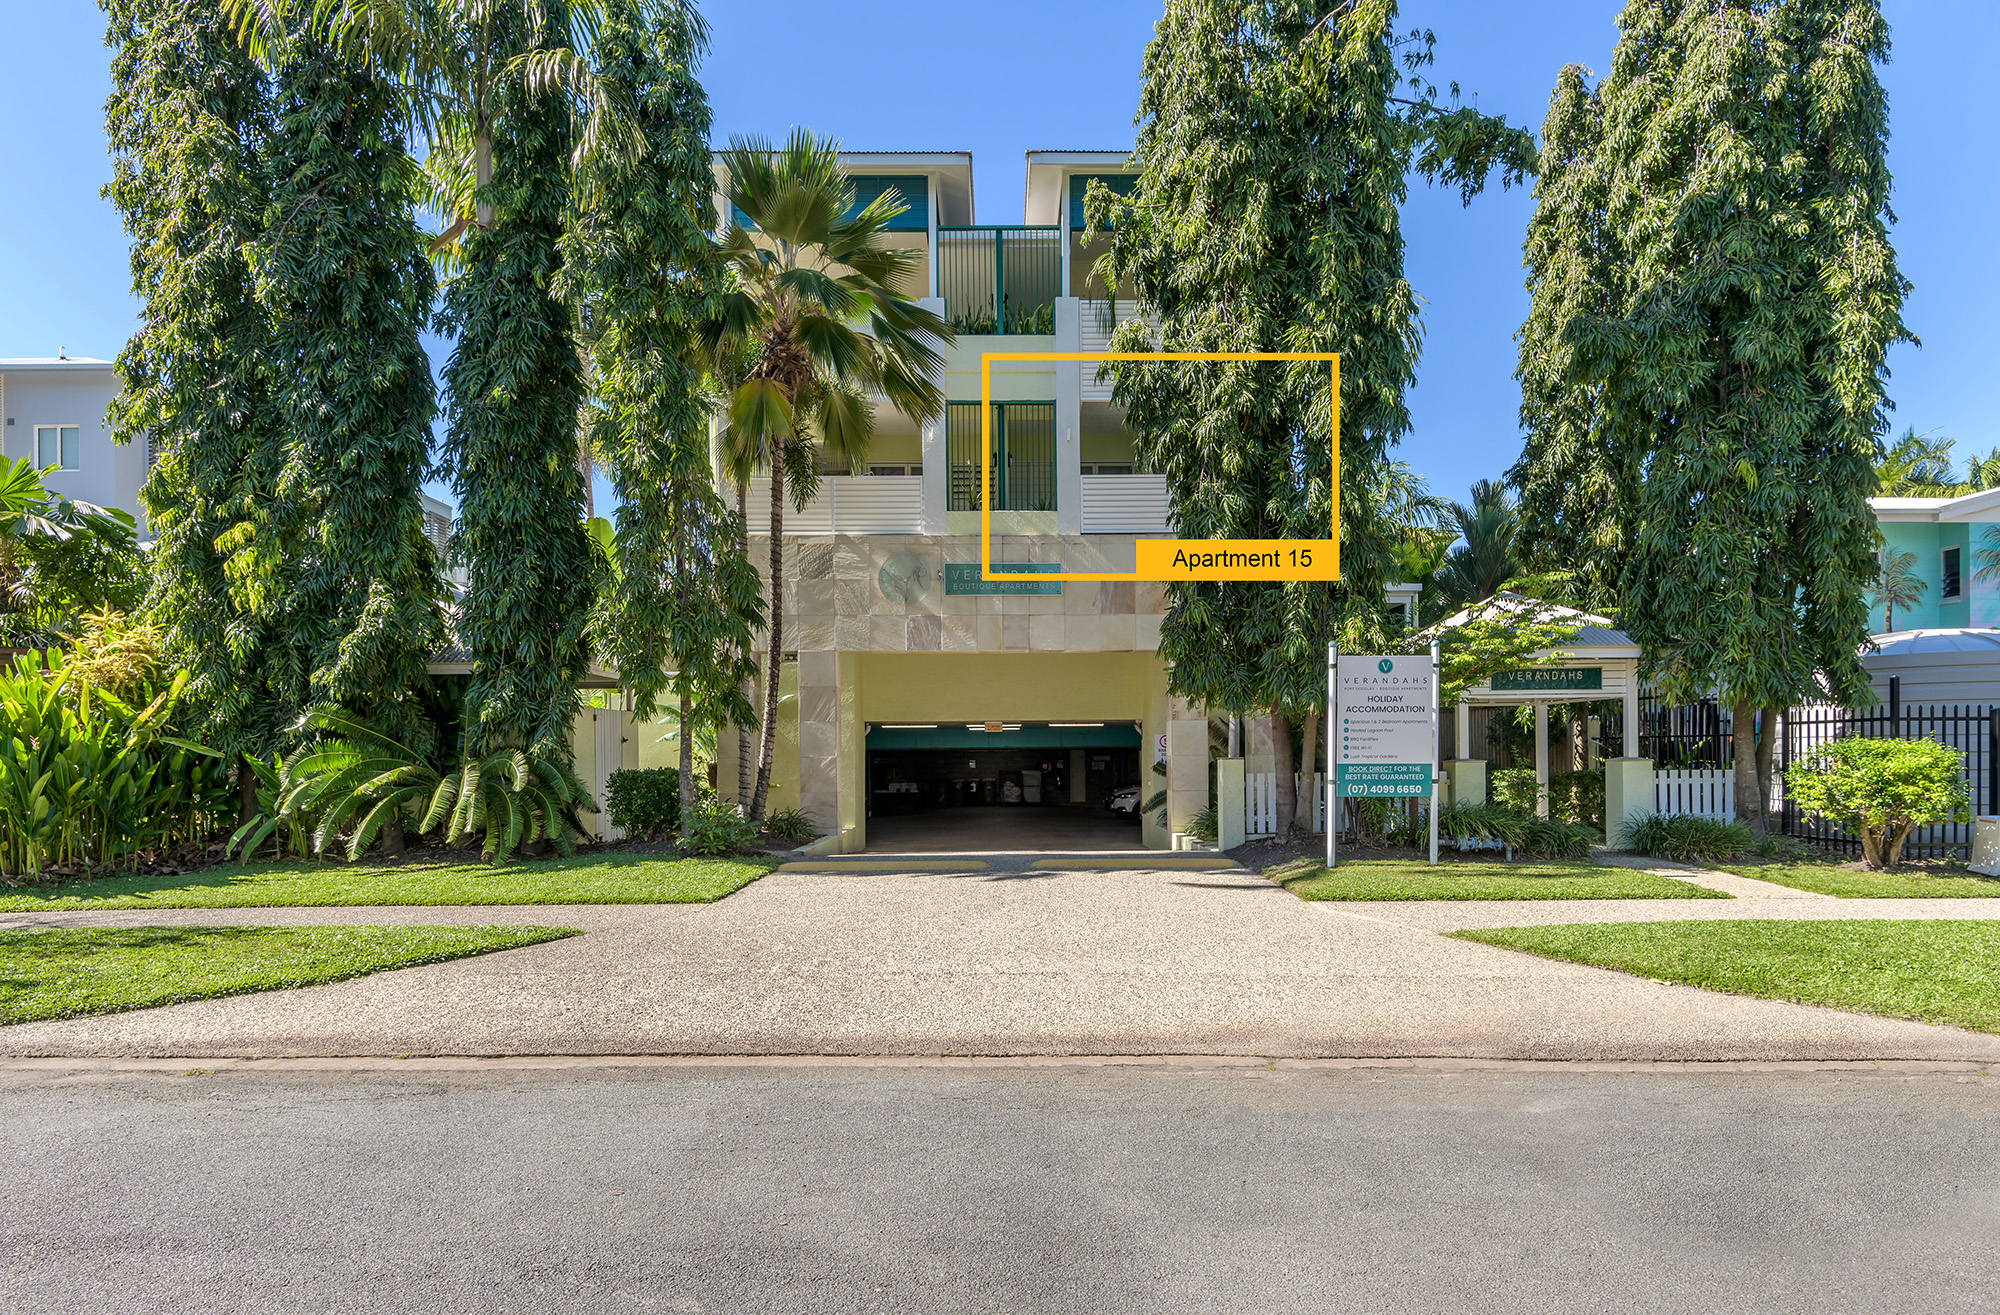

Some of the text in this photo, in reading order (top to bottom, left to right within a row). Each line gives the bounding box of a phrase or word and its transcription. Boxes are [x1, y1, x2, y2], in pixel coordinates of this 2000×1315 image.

[1381, 662, 1390, 671] V
[1508, 671, 1583, 680] VERANDAHS
[1348, 784, 1422, 795] (07) 4099 6650
